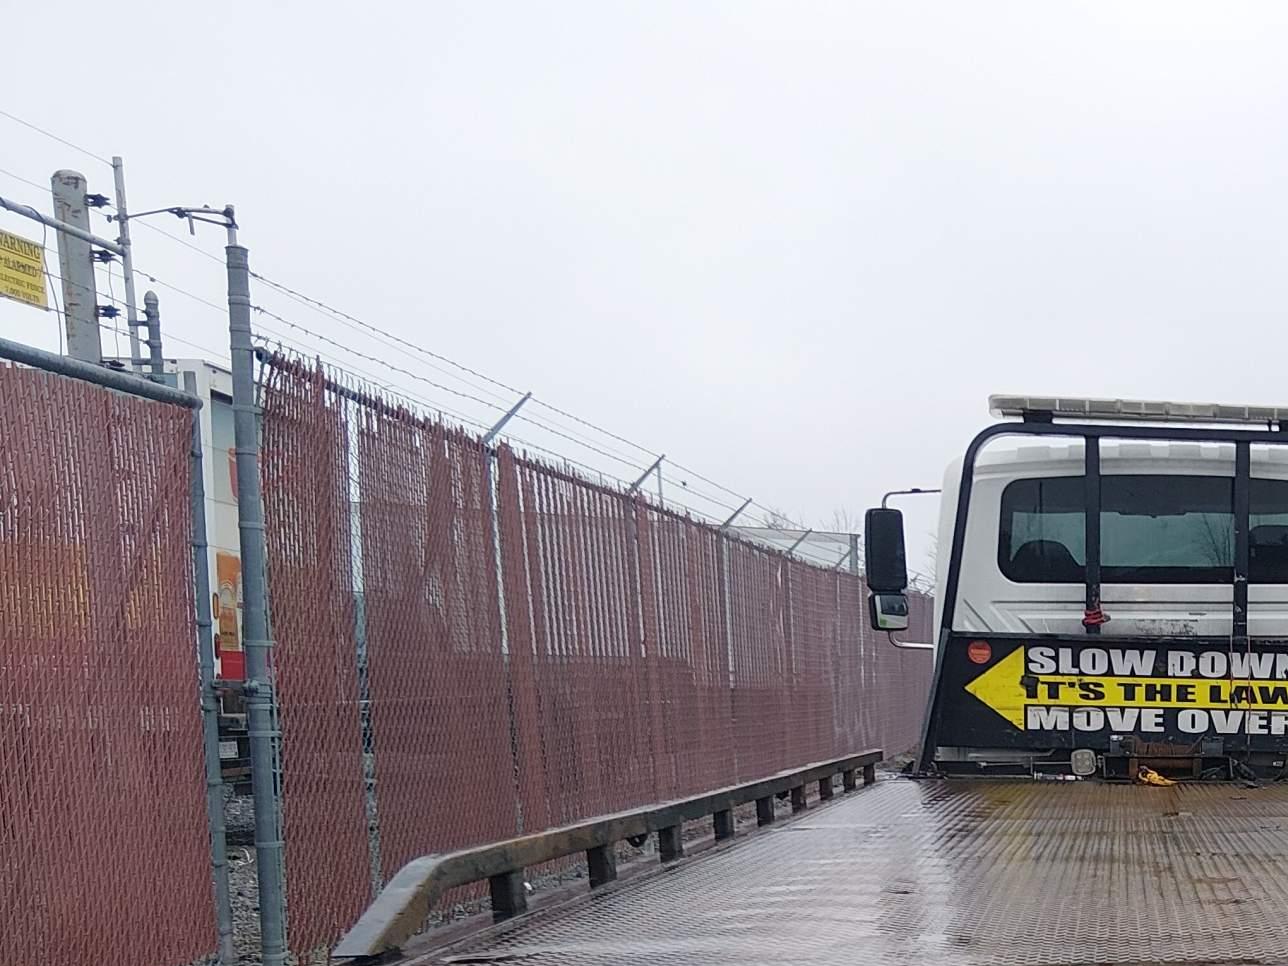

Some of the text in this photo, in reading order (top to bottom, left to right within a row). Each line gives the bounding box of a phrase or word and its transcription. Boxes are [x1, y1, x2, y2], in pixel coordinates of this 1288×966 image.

[1027, 647, 1156, 676] SLOW
[1023, 676, 1105, 701] IT'S
[1117, 682, 1197, 703] THE
[1027, 706, 1164, 732] MOVE
